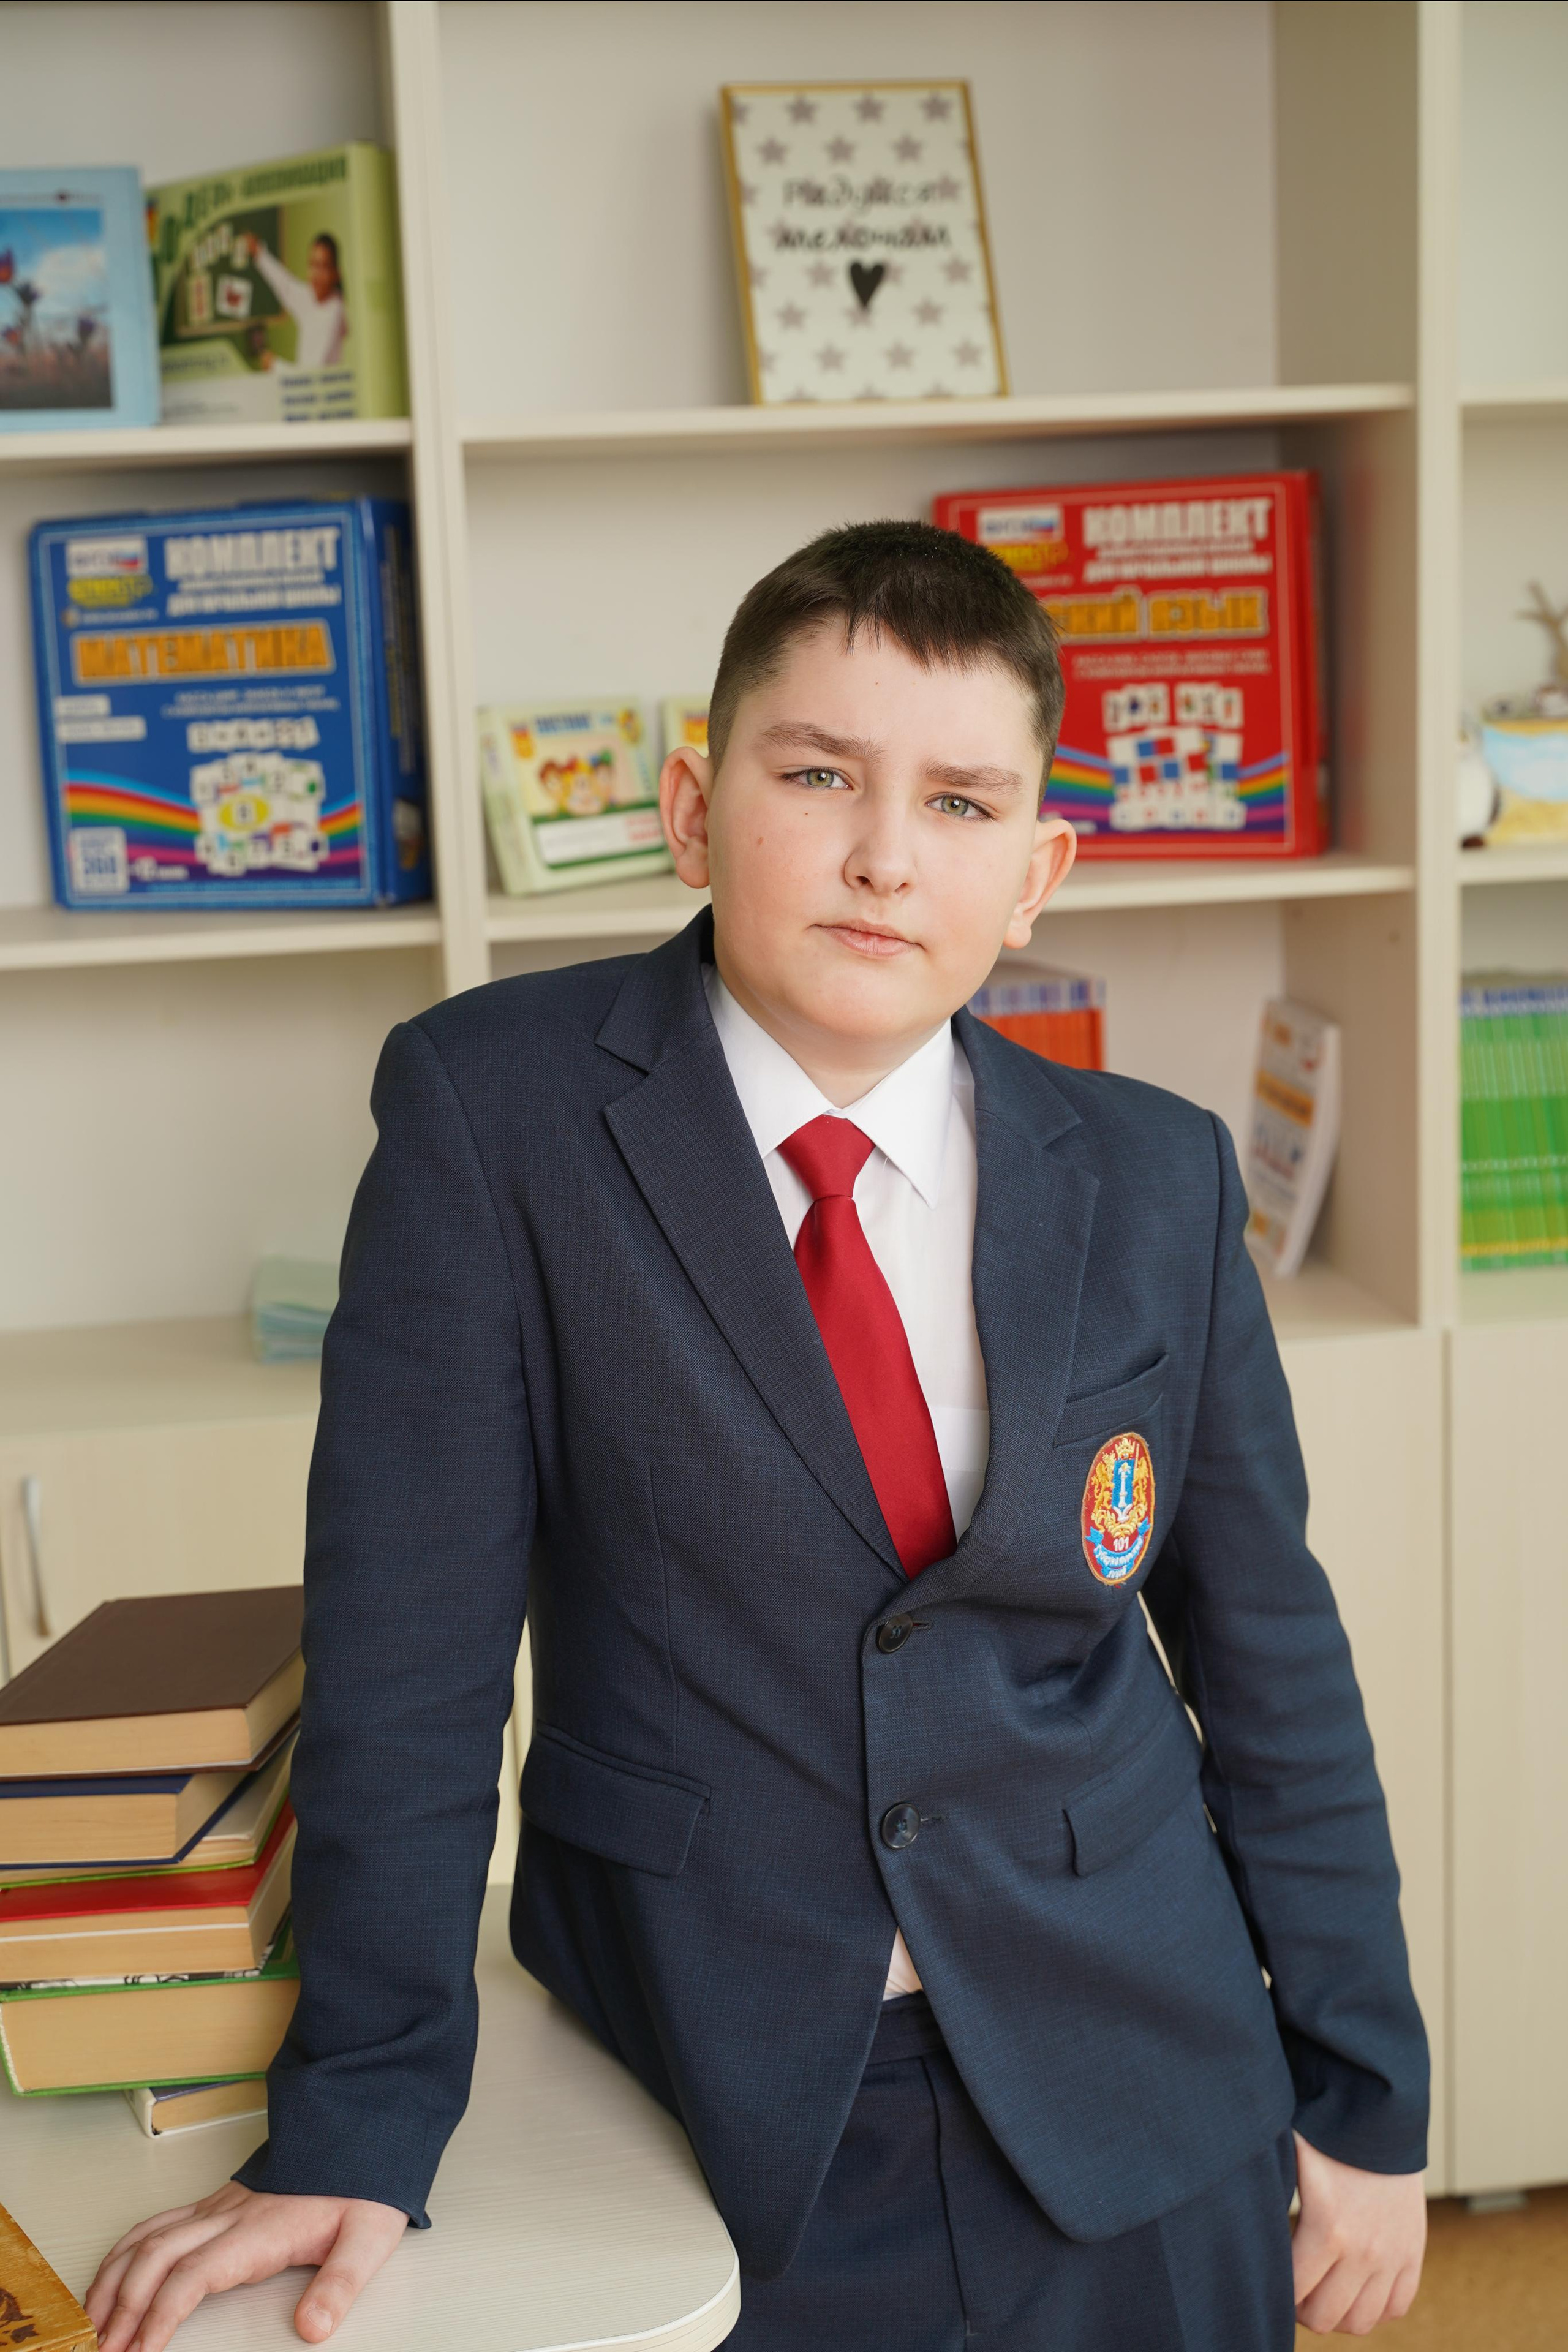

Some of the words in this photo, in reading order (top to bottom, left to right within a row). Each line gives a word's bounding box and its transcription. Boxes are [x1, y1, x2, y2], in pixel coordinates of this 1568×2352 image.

[1083, 497, 1272, 547] КОМПЛЕКТ
[165, 526, 340, 579] КОМПЛЕКТ
[1046, 588, 1140, 638] СКИЙ
[1149, 592, 1263, 636] ЯЗЫК
[75, 624, 332, 680] МАТЕМАТИКА
[1113, 1536, 1129, 1552] 101
